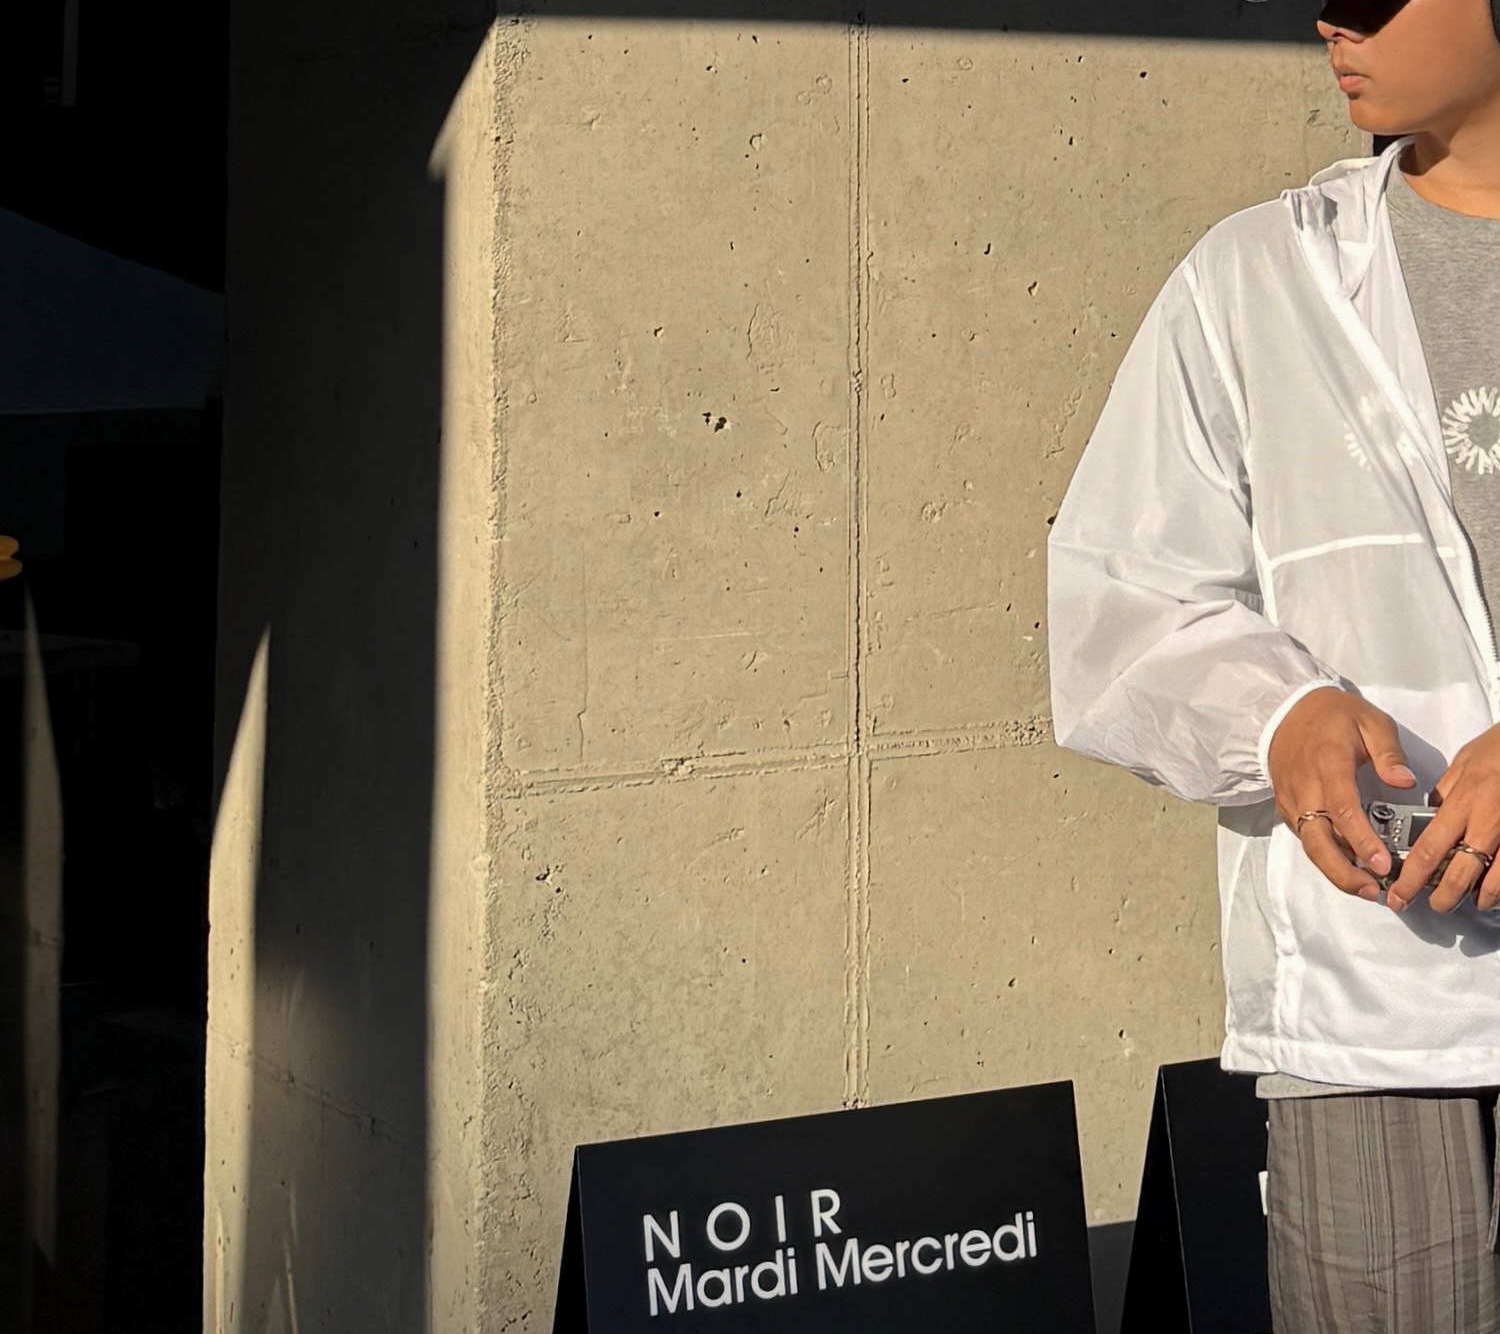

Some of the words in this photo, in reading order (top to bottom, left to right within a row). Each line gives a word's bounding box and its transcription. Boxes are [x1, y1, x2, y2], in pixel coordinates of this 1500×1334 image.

[643, 1189, 843, 1263] NOIR
[647, 1248, 799, 1317] Mardi
[815, 1210, 1038, 1291] Mercredi
